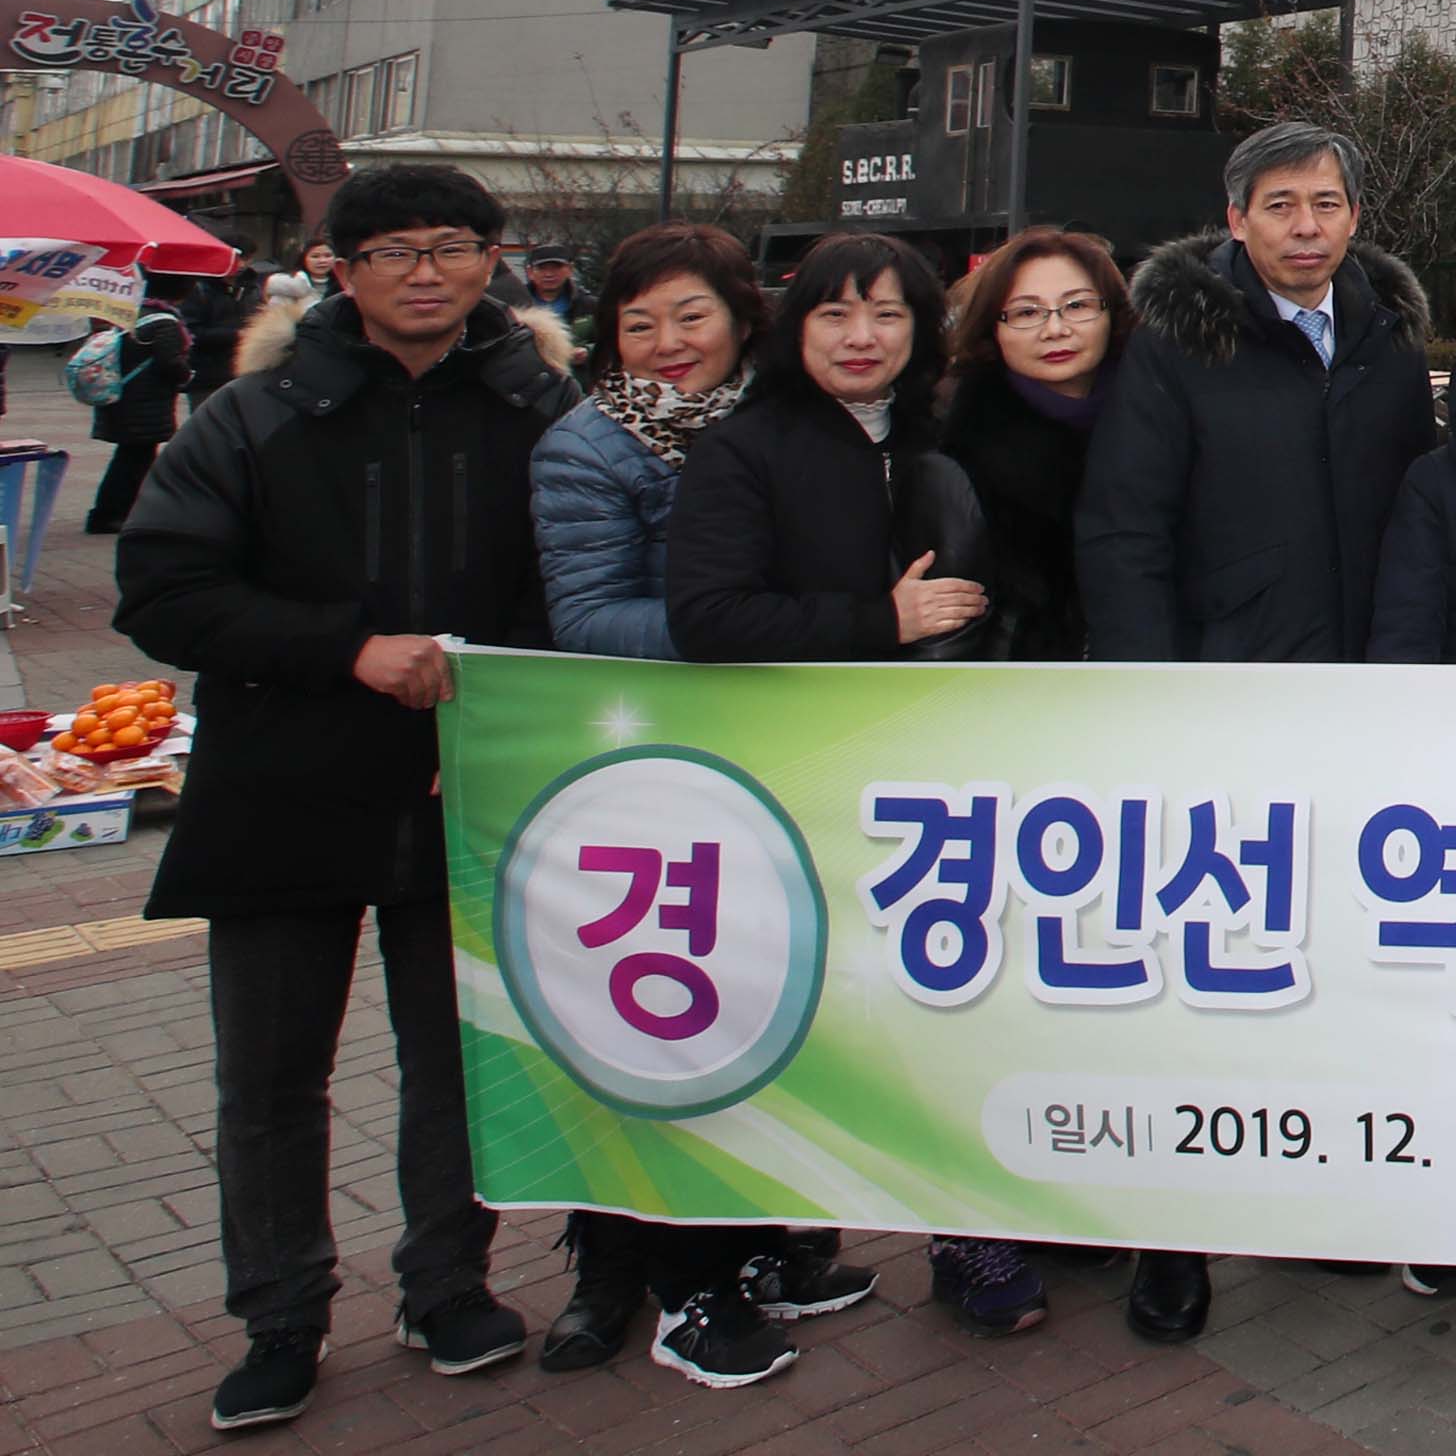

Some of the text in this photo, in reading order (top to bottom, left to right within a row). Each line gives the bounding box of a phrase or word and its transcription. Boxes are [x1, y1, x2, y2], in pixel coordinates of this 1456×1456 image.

[577, 841, 721, 1041] 경
[870, 795, 1297, 993] 경인선
[1043, 1103, 1138, 1157] 일시
[1174, 1104, 1328, 1164] 2019.
[1355, 1111, 1432, 1169] 12.
